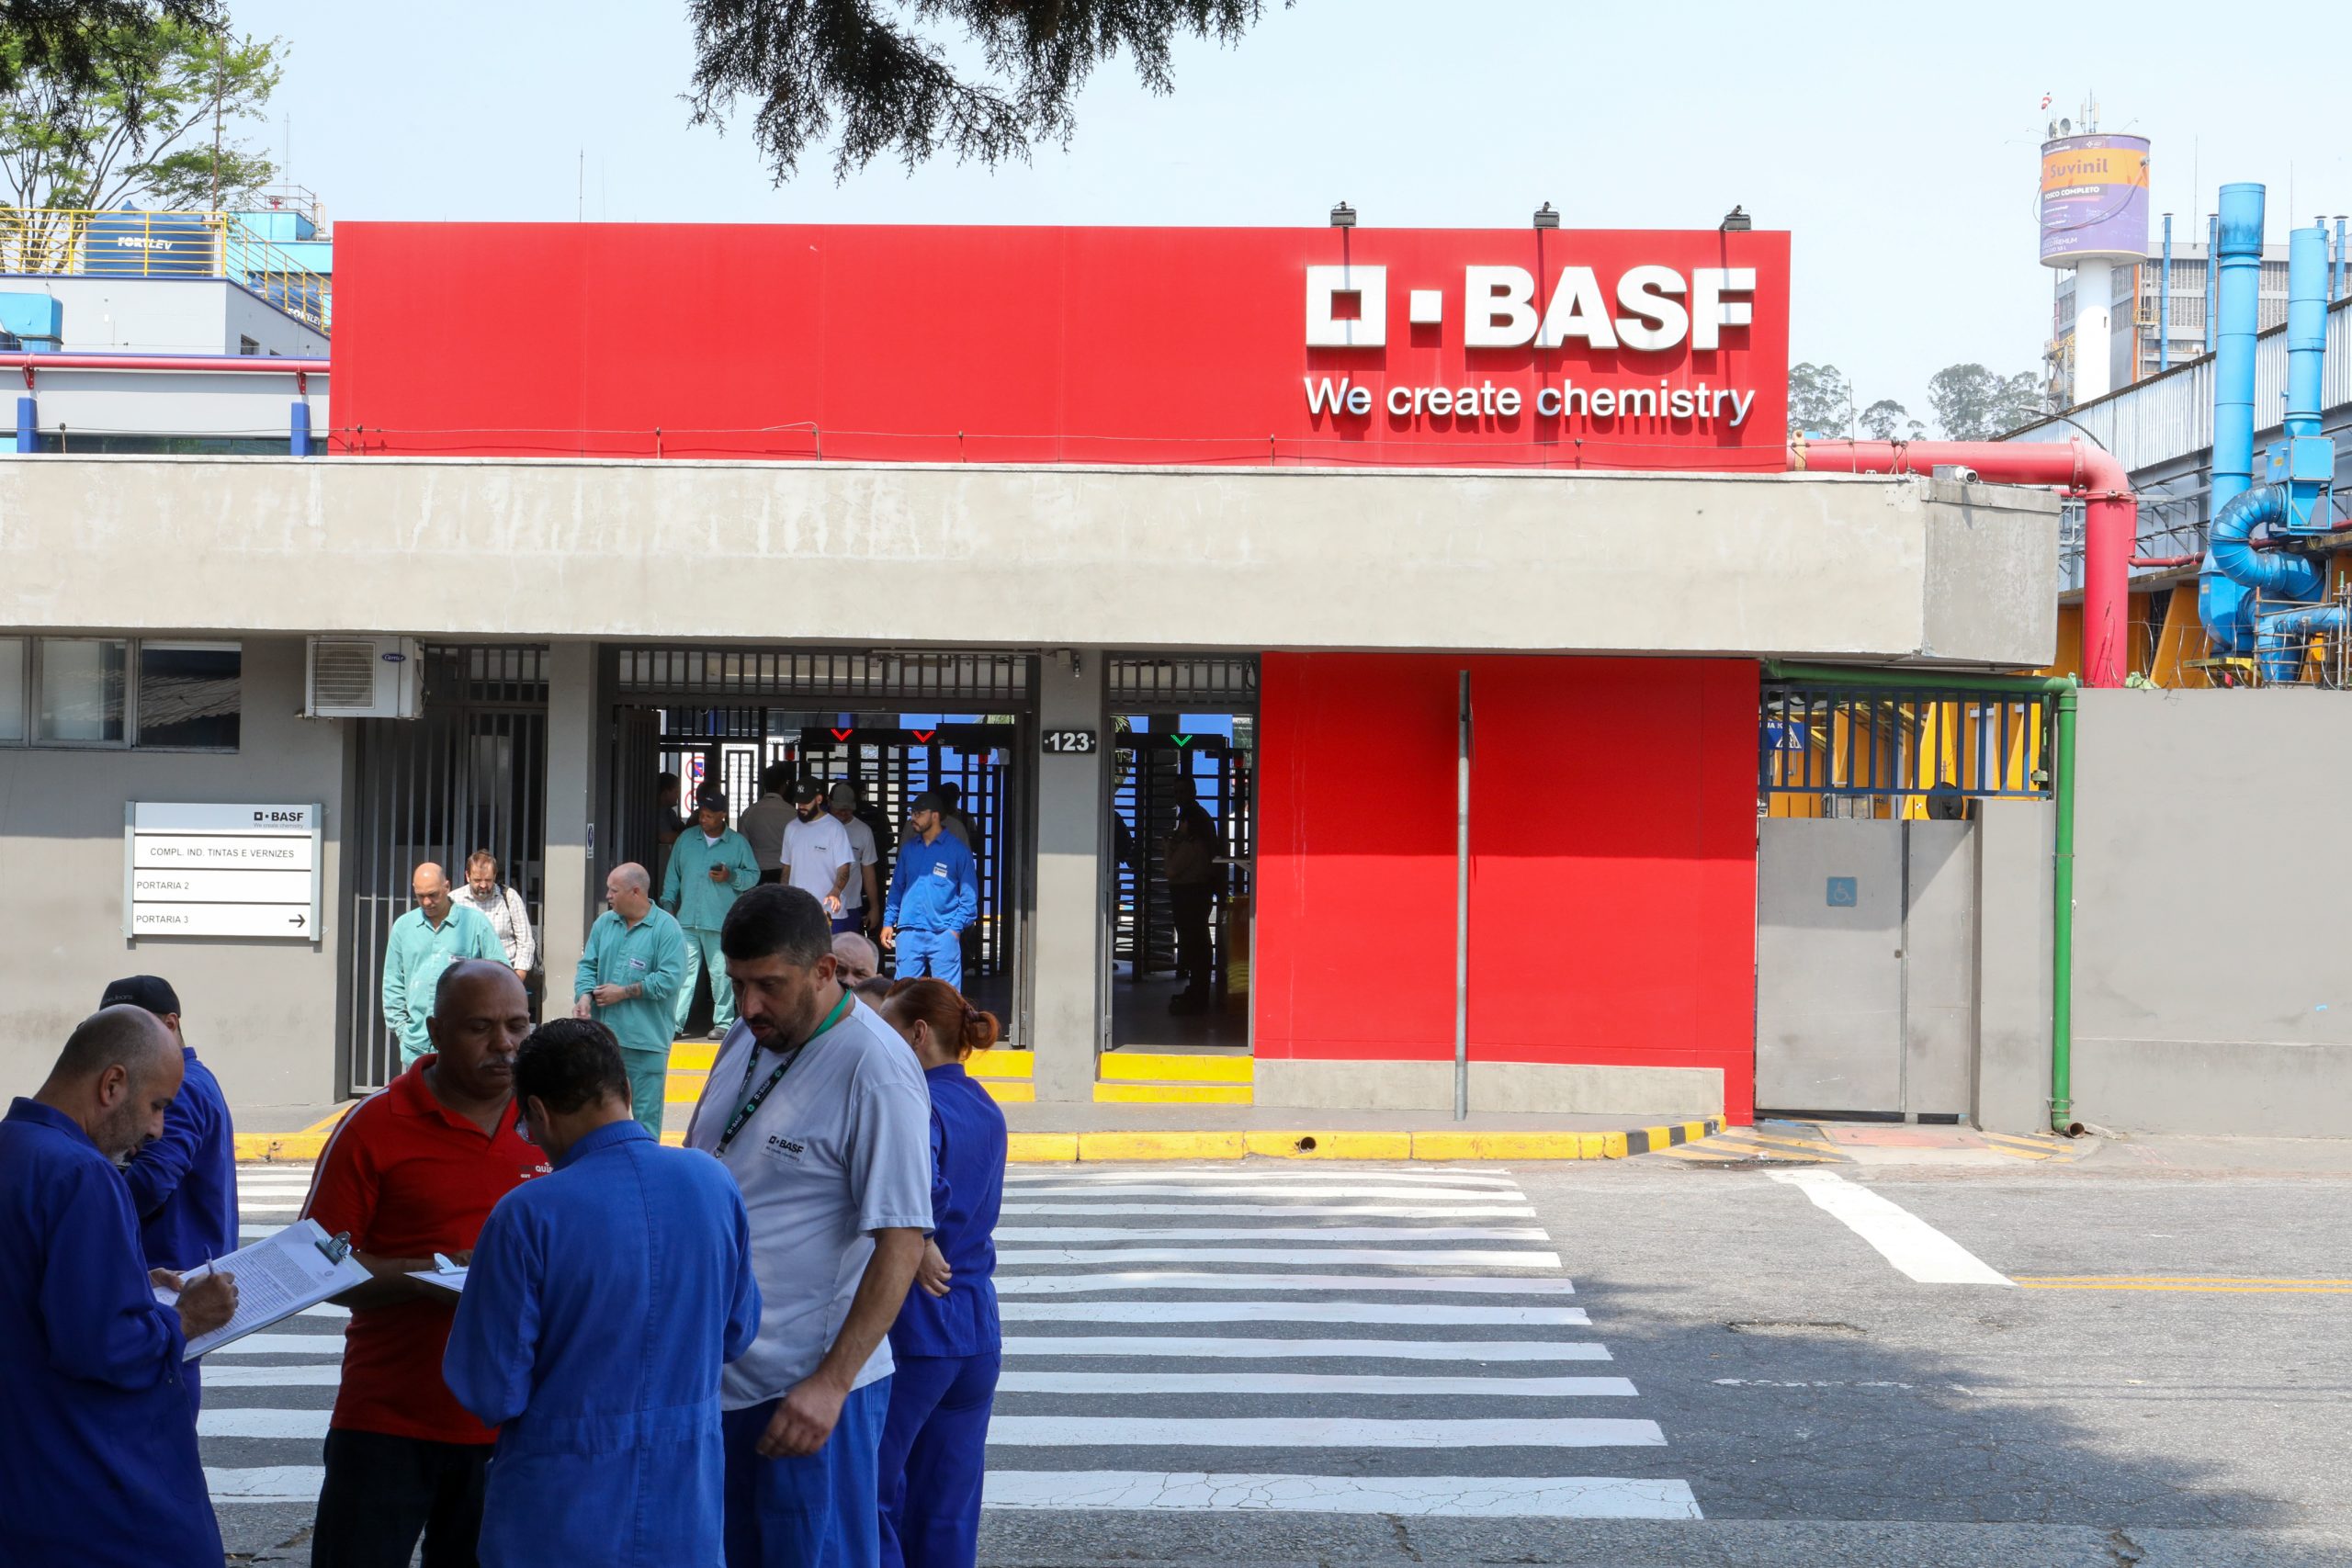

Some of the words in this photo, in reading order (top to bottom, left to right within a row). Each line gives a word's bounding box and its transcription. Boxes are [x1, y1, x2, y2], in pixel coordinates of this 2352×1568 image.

[2051, 158, 2109, 178] Suvinil
[2061, 186, 2100, 196] COMPLETO
[118, 236, 173, 250] FORTLEV
[1464, 265, 1756, 351] BASF
[1304, 377, 1372, 415] We
[1387, 379, 1521, 416] create
[1536, 378, 1756, 427] chemistry
[1050, 732, 1090, 751] 123
[271, 811, 304, 822] BASF
[150, 847, 185, 856] COMPL.
[187, 848, 205, 857] IND.
[209, 848, 239, 857] TINTAS
[242, 849, 247, 857] E
[250, 849, 295, 858] VERNIZES
[136, 881, 182, 889] PORTARIA
[184, 882, 189, 890] 2
[136, 915, 182, 923] PORTARIA
[184, 915, 189, 924] 3
[779, 1139, 805, 1154] BASF
